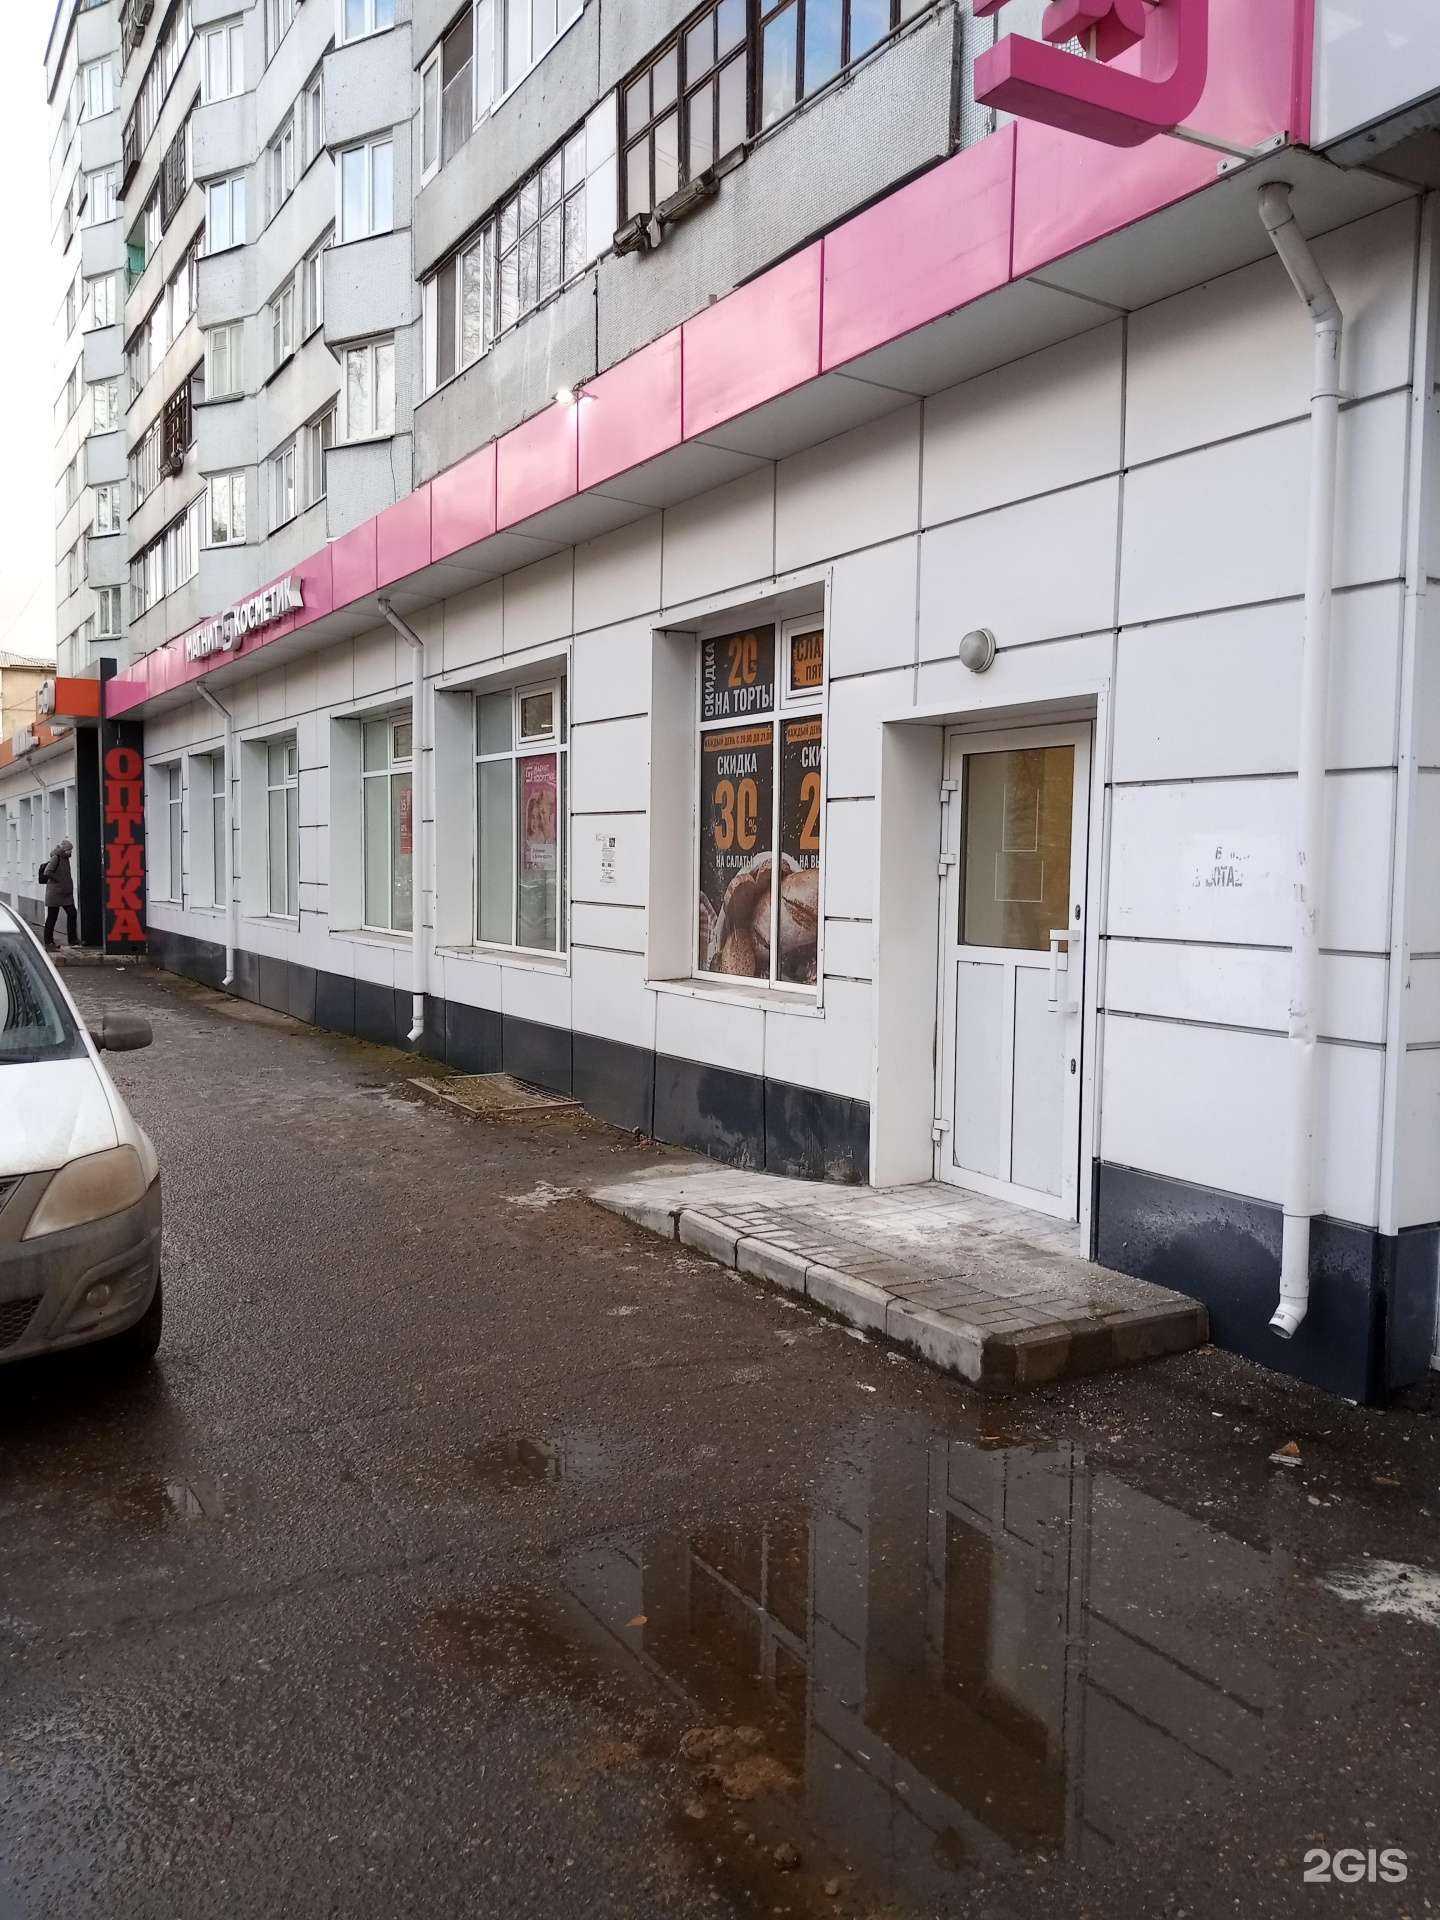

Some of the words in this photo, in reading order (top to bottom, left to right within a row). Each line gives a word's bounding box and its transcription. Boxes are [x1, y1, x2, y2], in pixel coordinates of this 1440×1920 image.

[185, 619, 222, 662] МАГНИТ
[234, 576, 299, 637] КОСМЕТИК
[704, 642, 717, 717] СКИДКА
[715, 691, 730, 715] НА
[733, 683, 773, 713] ТОРТЫ
[717, 753, 758, 777] СКИДКА
[104, 747, 146, 942] ОПТИКА
[716, 855, 725, 868] НА
[726, 855, 753, 868] САЛАТЫ
[799, 855, 809, 868] НА
